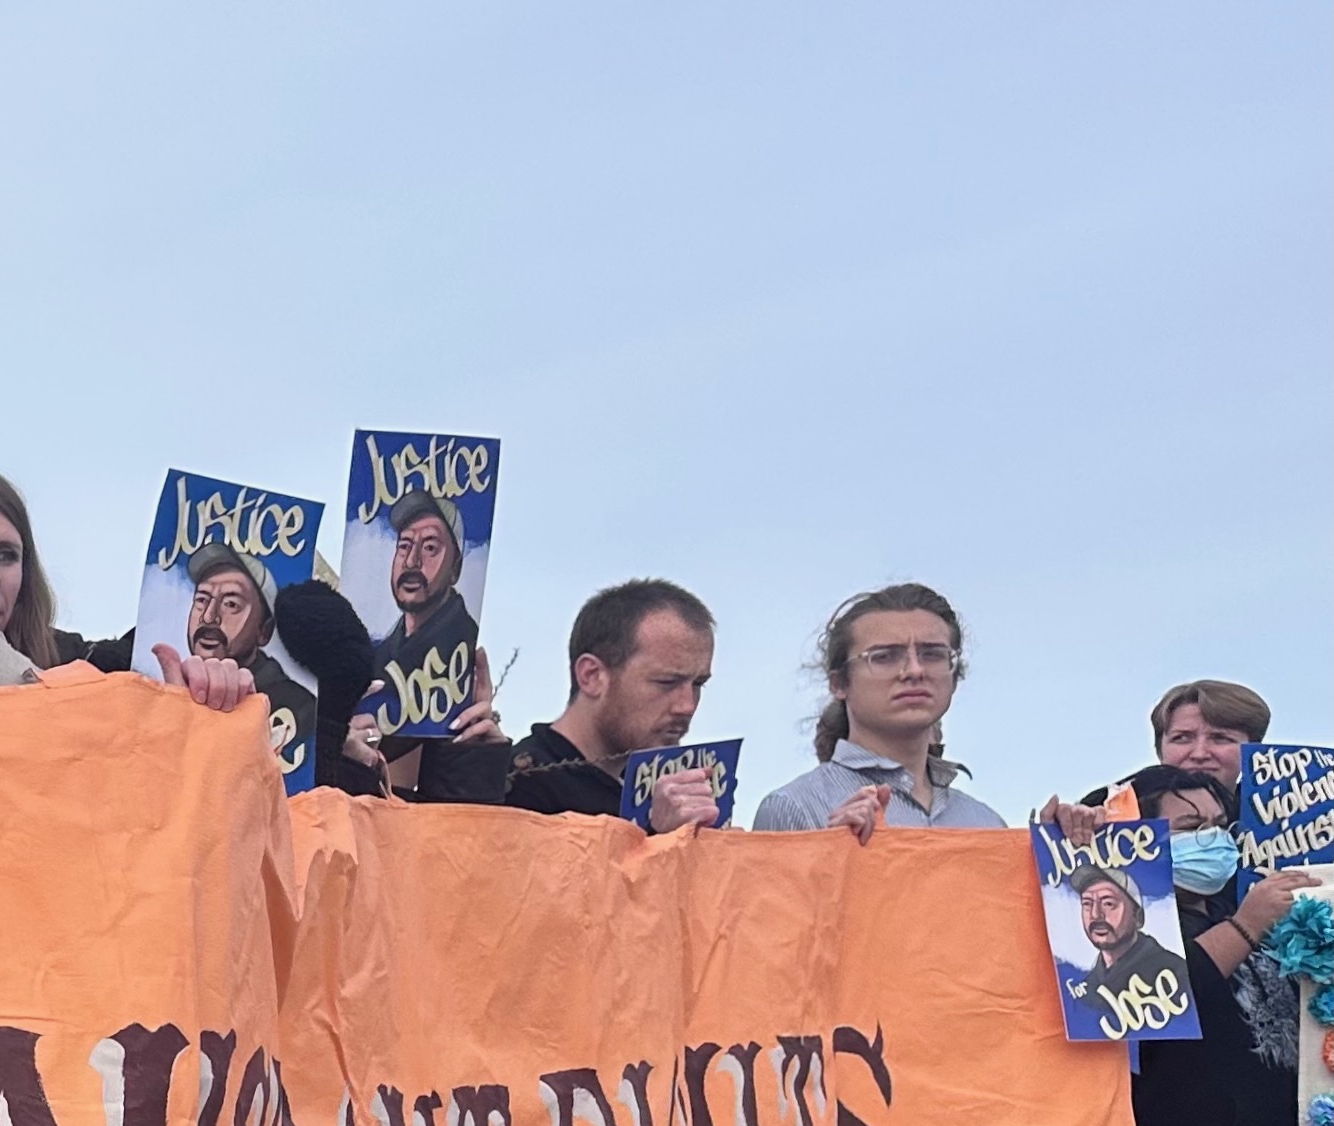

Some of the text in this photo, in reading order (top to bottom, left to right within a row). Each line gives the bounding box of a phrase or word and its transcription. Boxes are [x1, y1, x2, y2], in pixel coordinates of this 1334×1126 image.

[358, 433, 492, 525] Justice
[158, 475, 306, 571] Justice
[376, 641, 473, 736] Jose
[1252, 747, 1313, 786] Stop
[1236, 808, 1334, 874] Agains
[1065, 968, 1189, 1040] for Jose
